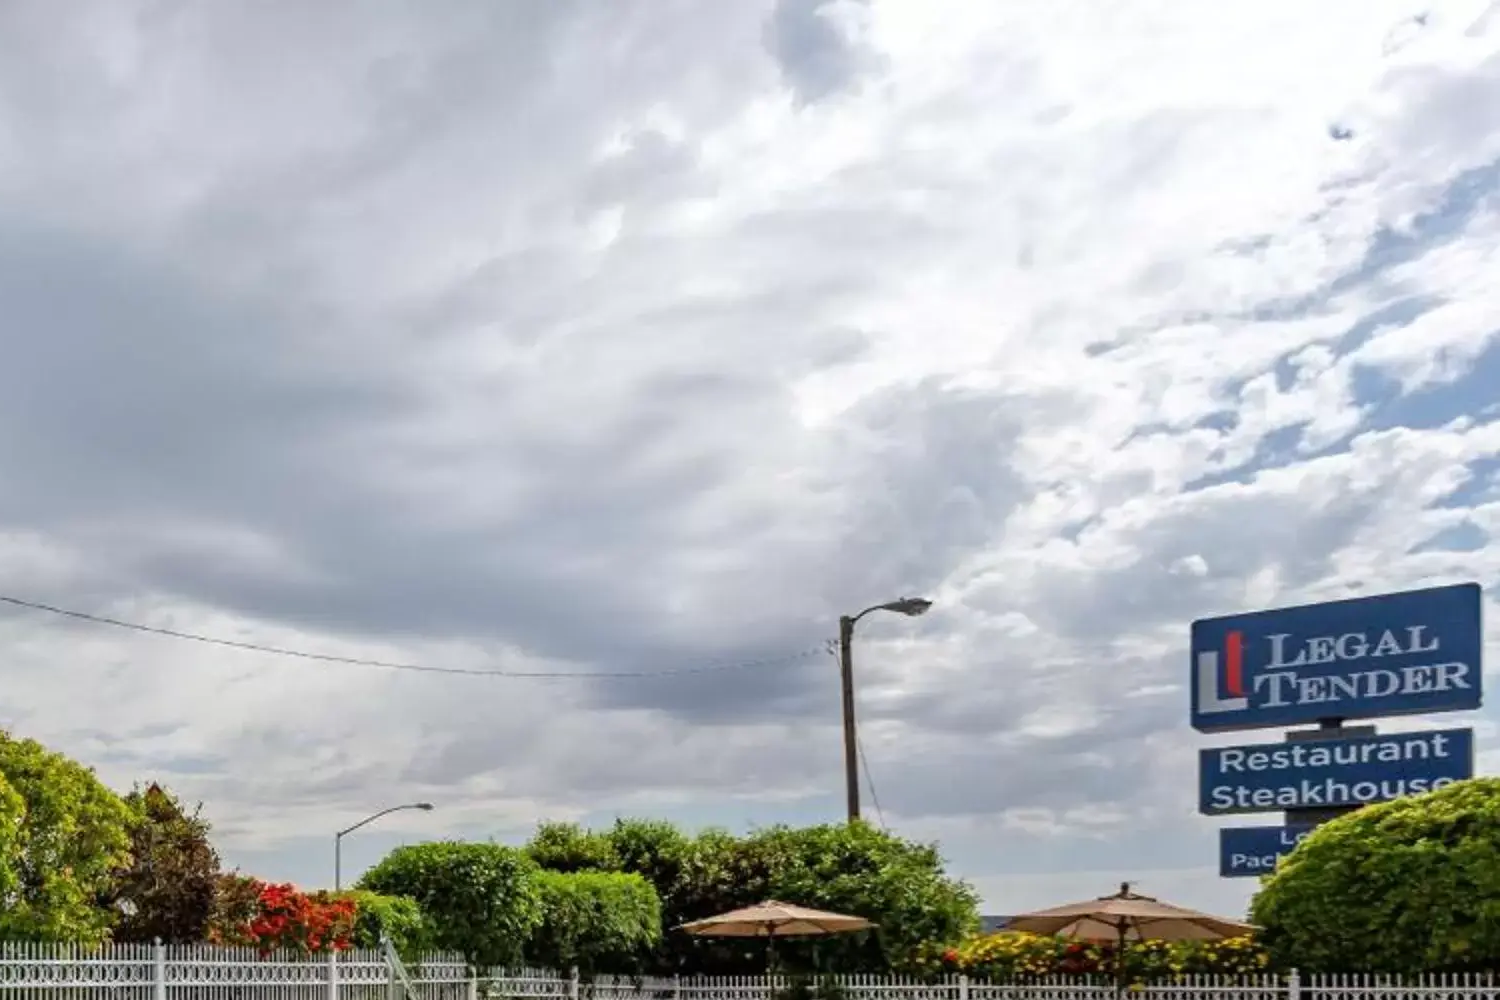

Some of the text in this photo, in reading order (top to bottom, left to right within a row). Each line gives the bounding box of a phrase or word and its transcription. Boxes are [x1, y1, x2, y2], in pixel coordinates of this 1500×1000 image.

[1265, 626, 1440, 669] LEGAL
[1253, 663, 1472, 708] TENDER
[1219, 733, 1449, 773] Restaurant
